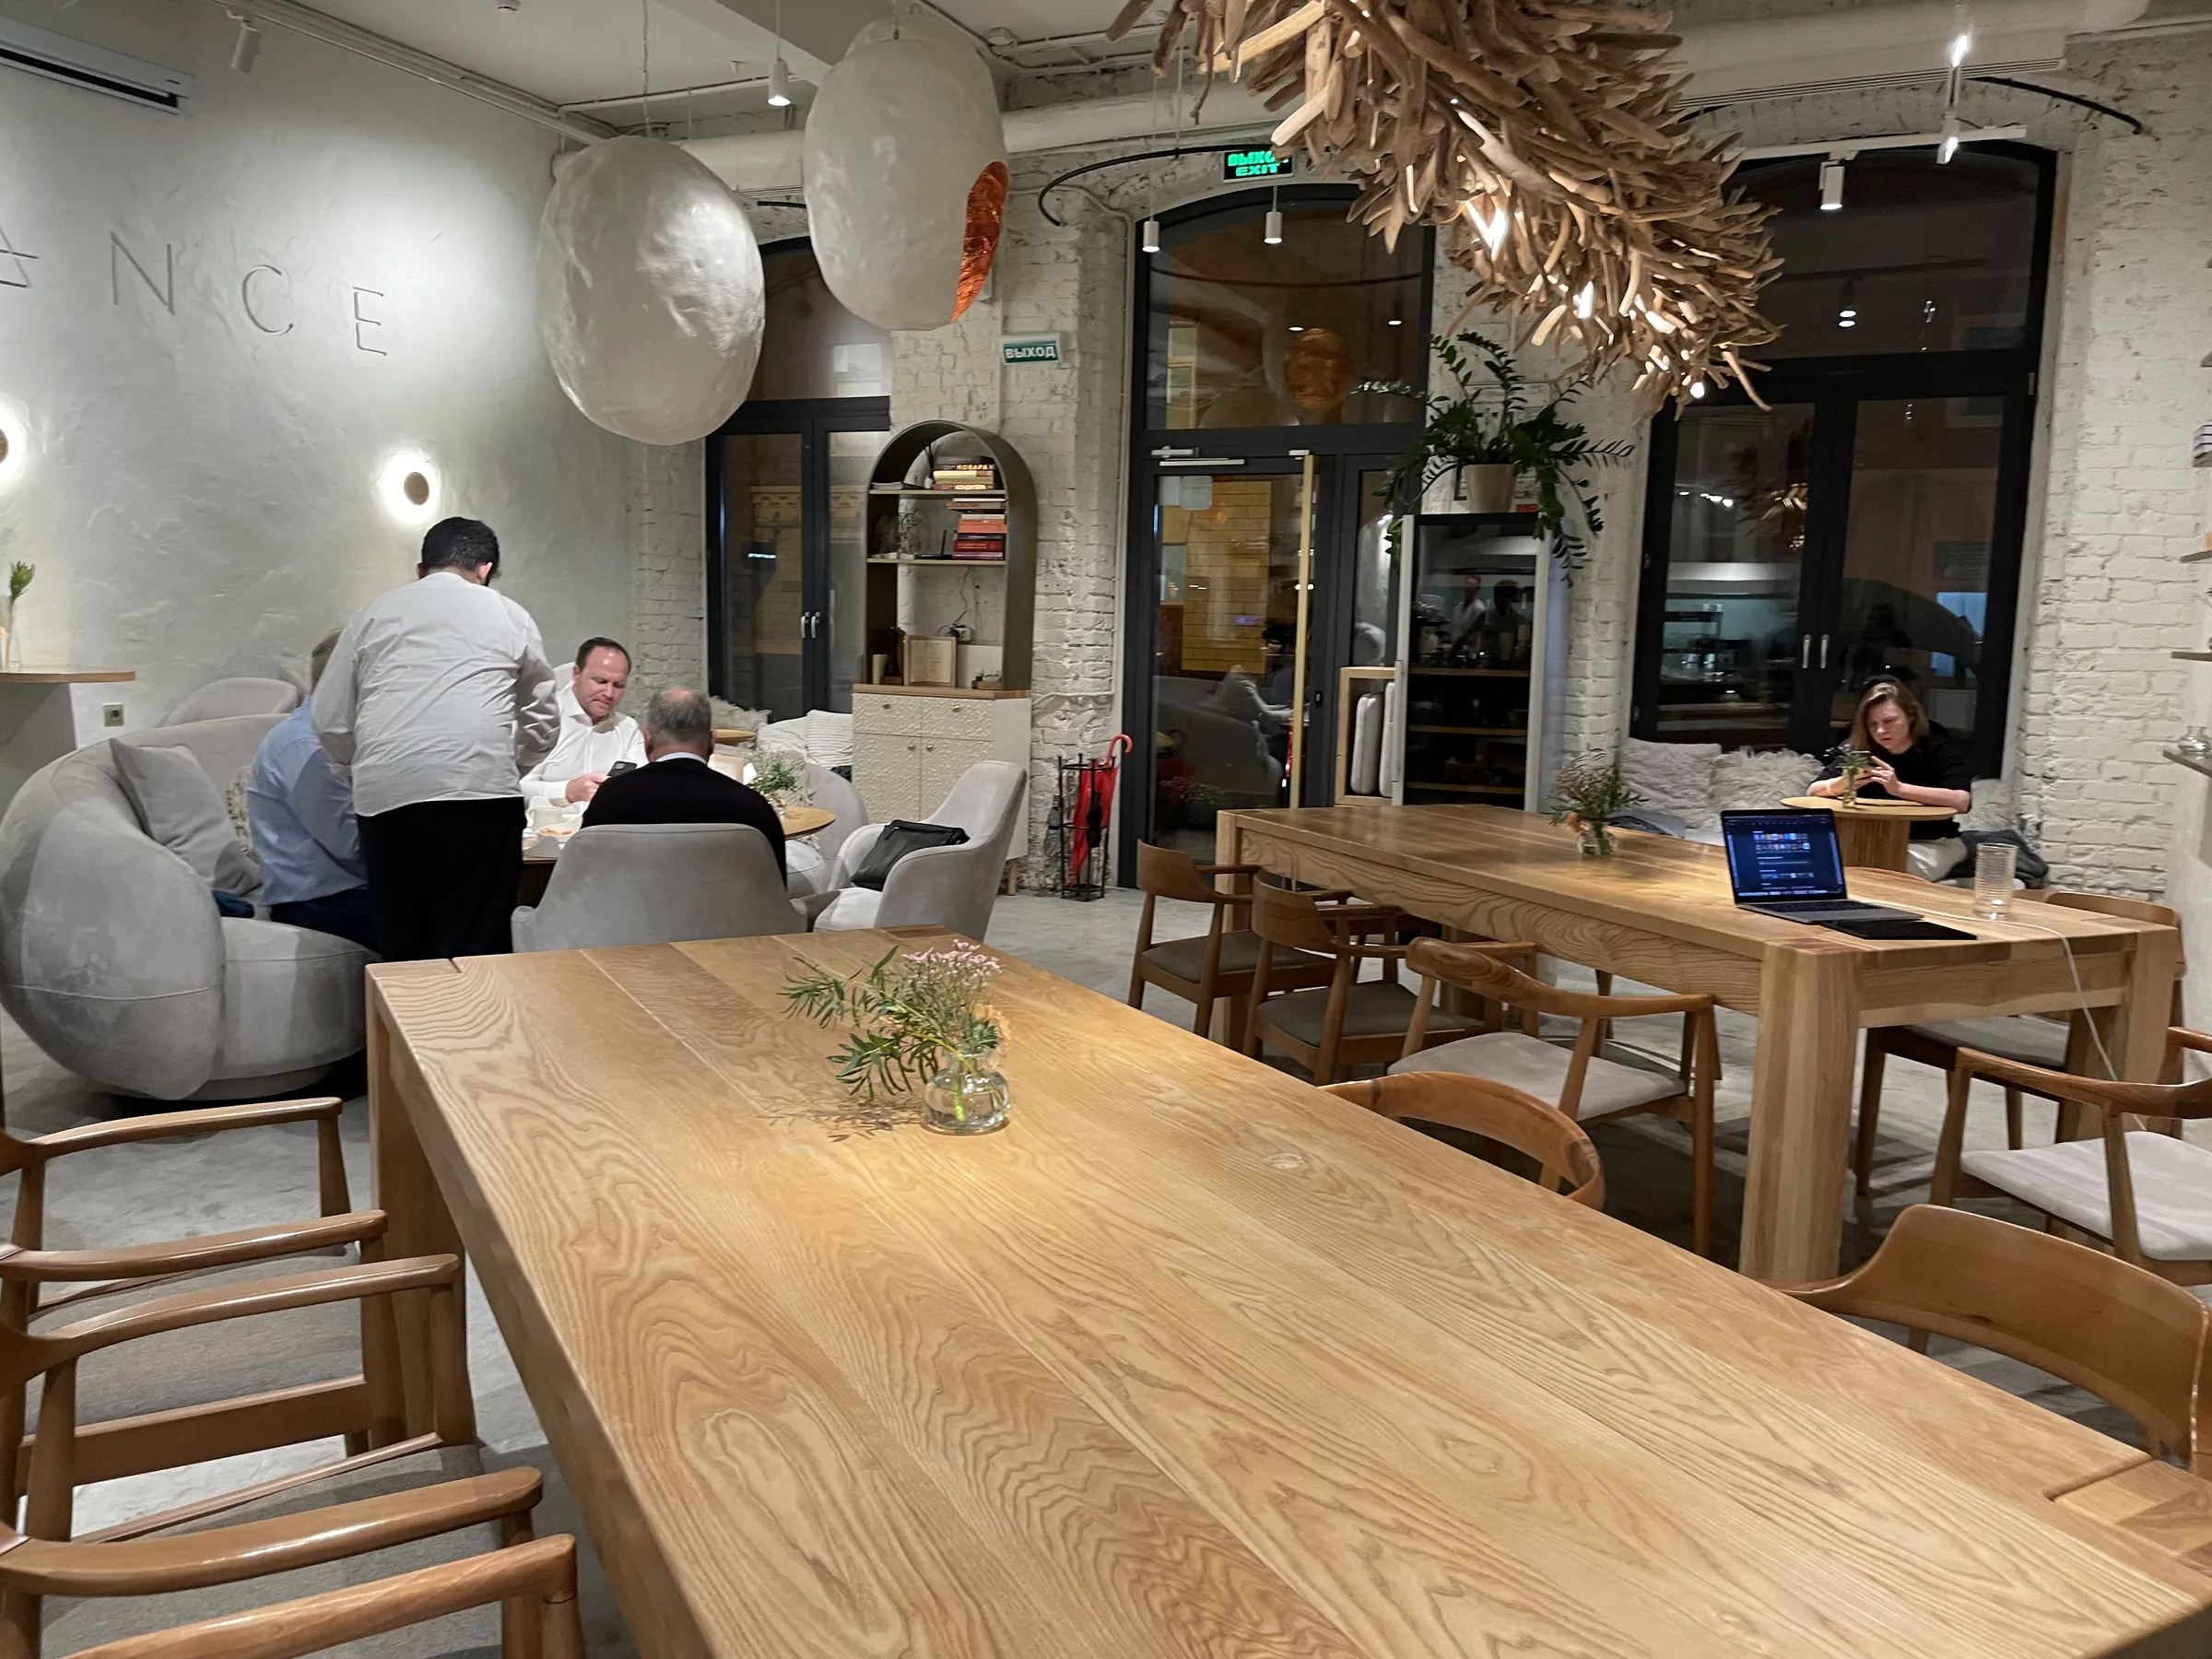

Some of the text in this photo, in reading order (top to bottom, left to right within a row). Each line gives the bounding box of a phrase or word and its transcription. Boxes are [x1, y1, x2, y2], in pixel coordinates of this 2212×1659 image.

[1228, 150, 1289, 166] ВЫХО
[1236, 163, 1280, 176] EXIT
[1005, 346, 1056, 359] ВЫХОД
